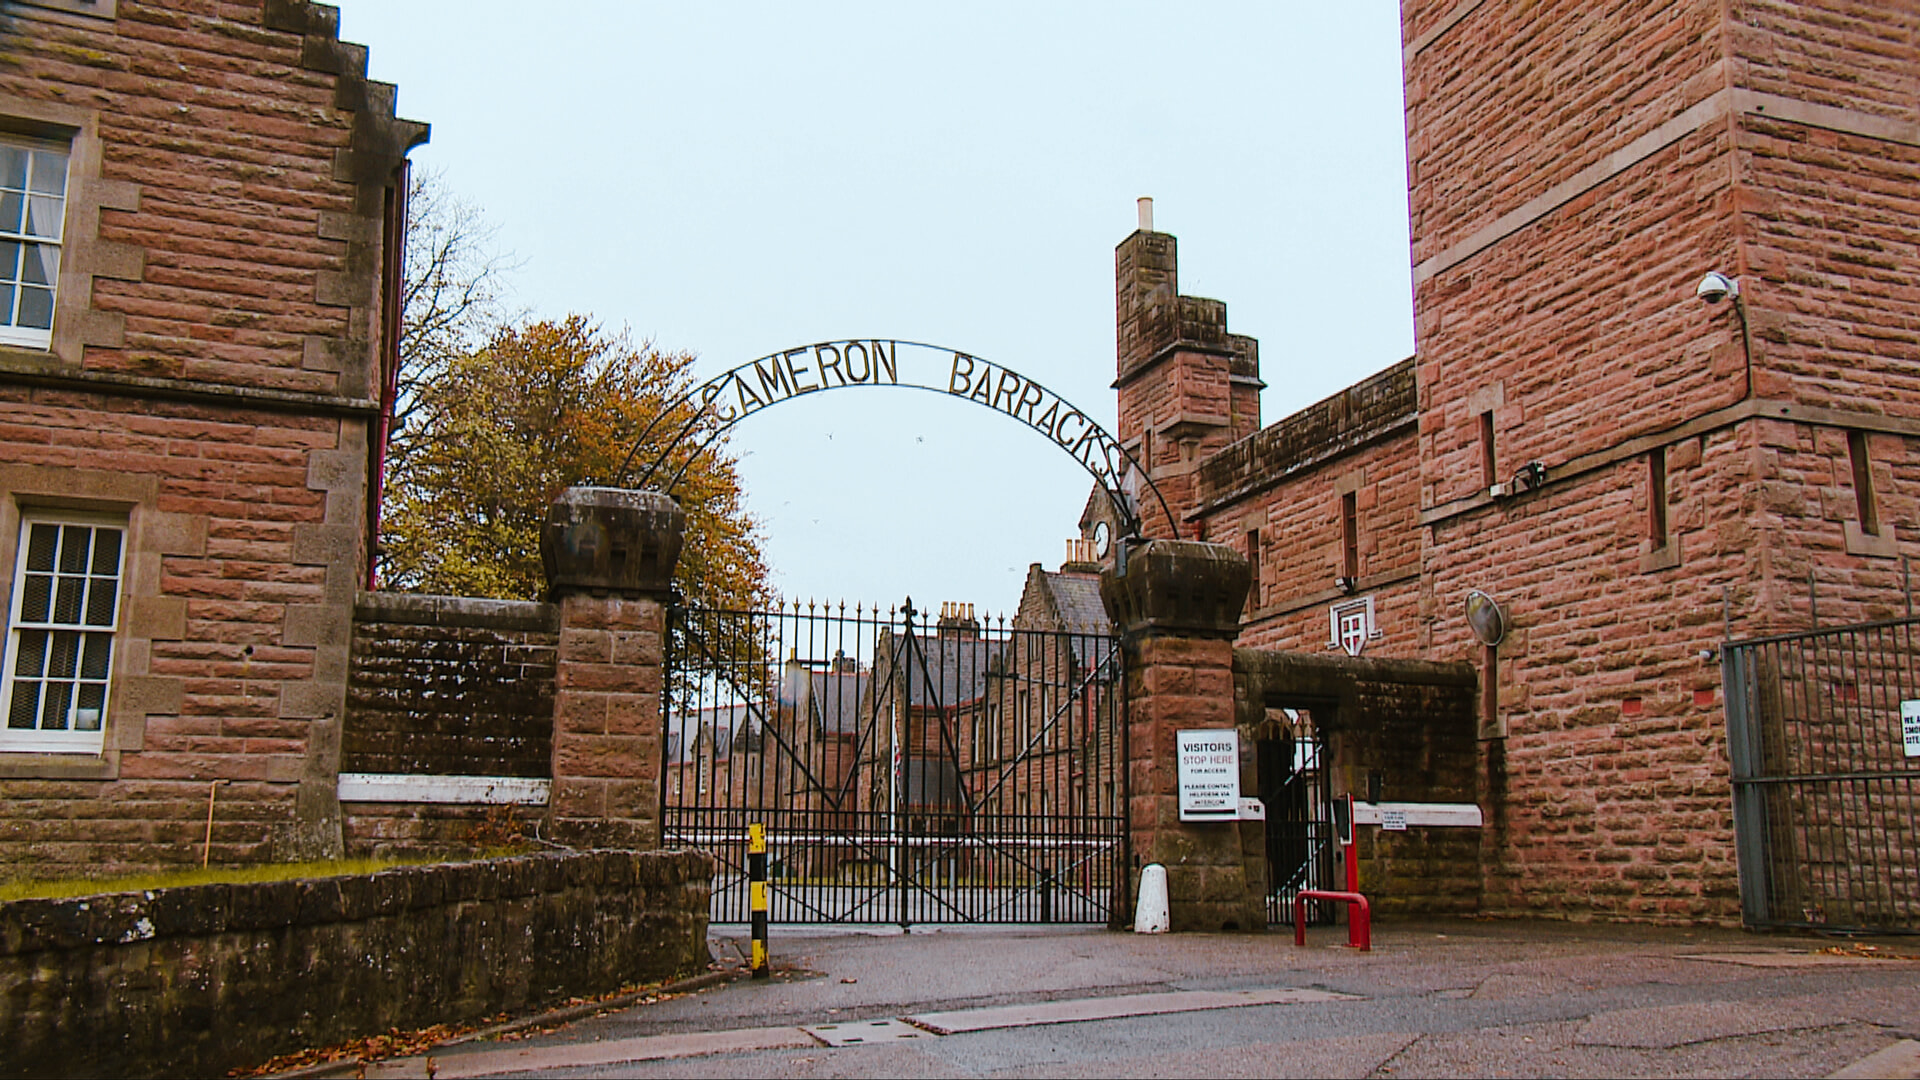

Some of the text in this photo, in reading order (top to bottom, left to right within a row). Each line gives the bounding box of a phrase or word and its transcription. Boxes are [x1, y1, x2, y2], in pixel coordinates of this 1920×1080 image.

[702, 340, 1123, 476] CAMERON BARRACKS
[1183, 743, 1232, 752] VISITORS
[1183, 755, 1233, 765] STOP HERE
